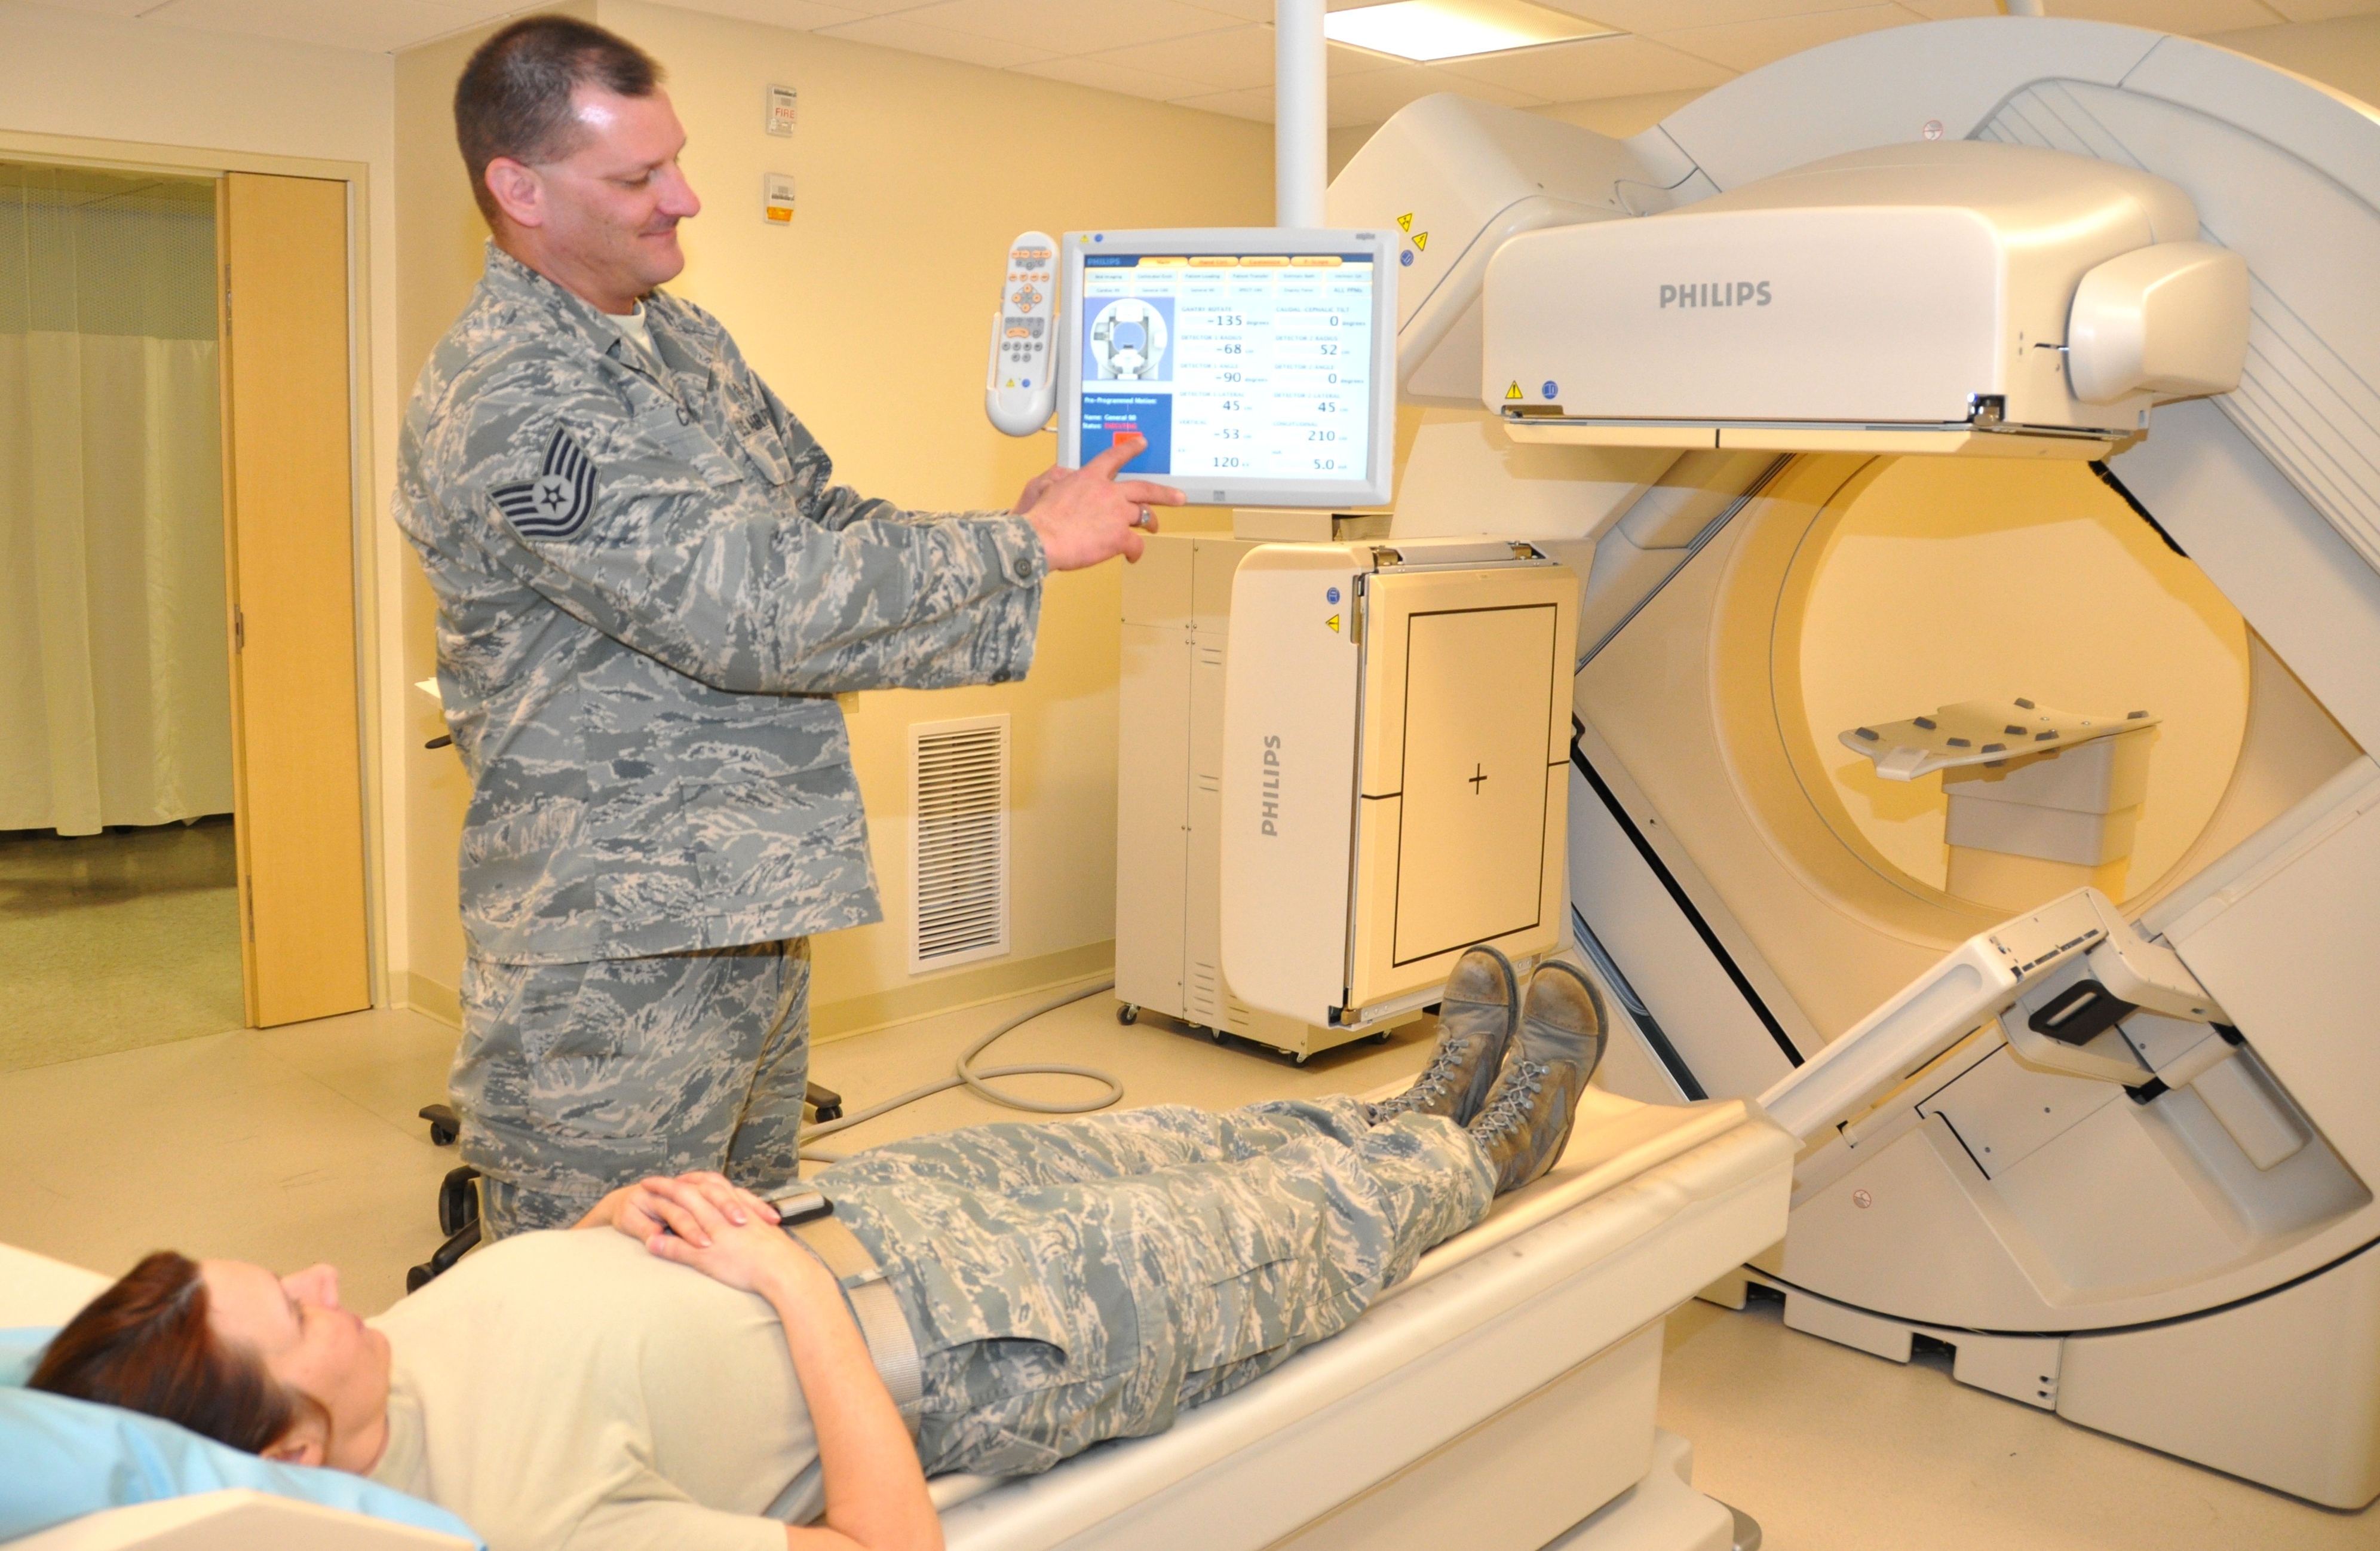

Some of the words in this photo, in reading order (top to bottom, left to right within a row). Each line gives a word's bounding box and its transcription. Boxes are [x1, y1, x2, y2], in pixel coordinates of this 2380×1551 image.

[775, 108, 795, 119] FIRE
[1660, 280, 1772, 308] PHILIPS
[1207, 315, 1242, 326] -135
[1330, 315, 1339, 326] 0
[1216, 344, 1242, 354] -68
[1320, 344, 1338, 355] 52
[1216, 372, 1241, 382] -90
[1328, 373, 1337, 384] 0
[1222, 400, 1240, 410] 45
[1318, 401, 1335, 412] 45
[1214, 428, 1240, 439] -53
[1308, 430, 1335, 441] 210
[1213, 456, 1239, 467] 120
[1314, 459, 1335, 470] 5.0
[1261, 735, 1281, 836] PHILIPS
